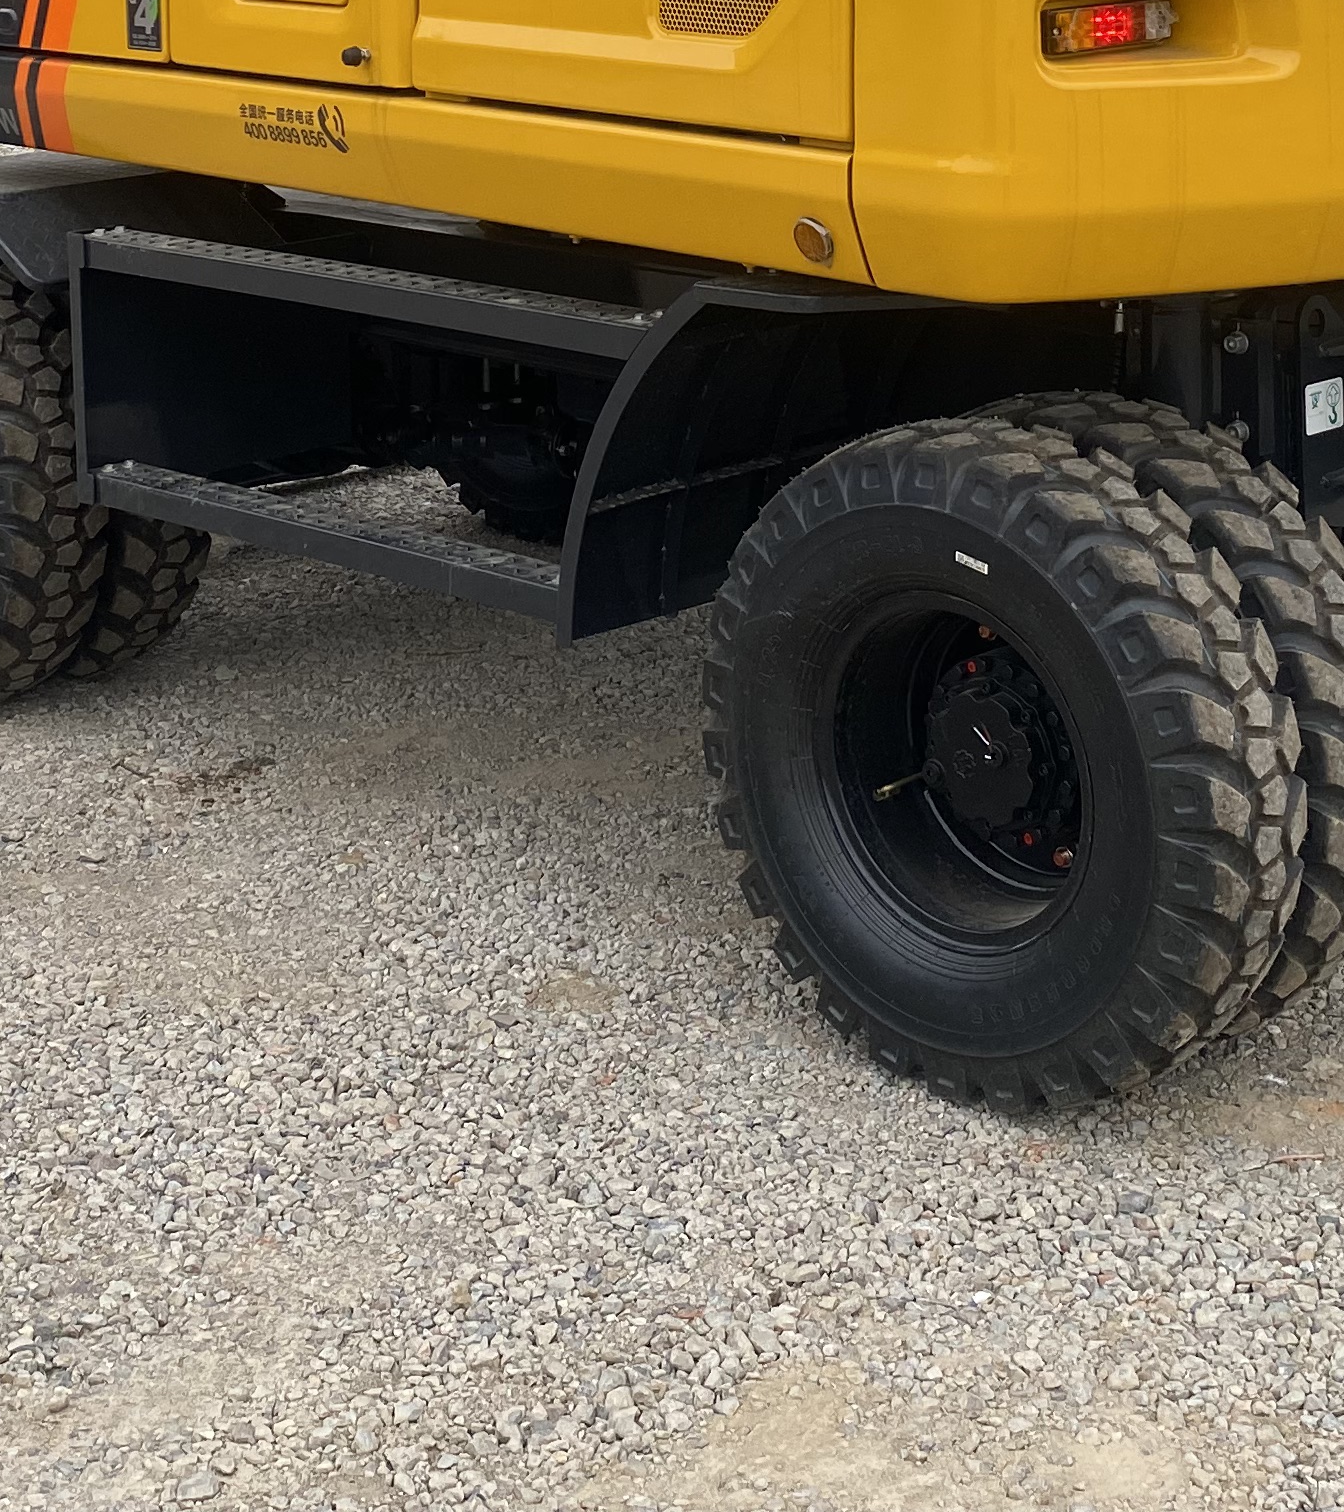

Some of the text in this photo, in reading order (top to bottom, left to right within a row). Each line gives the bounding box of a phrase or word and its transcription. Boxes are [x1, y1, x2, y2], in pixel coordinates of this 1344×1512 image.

[244, 121, 328, 149] 400 8899 856
